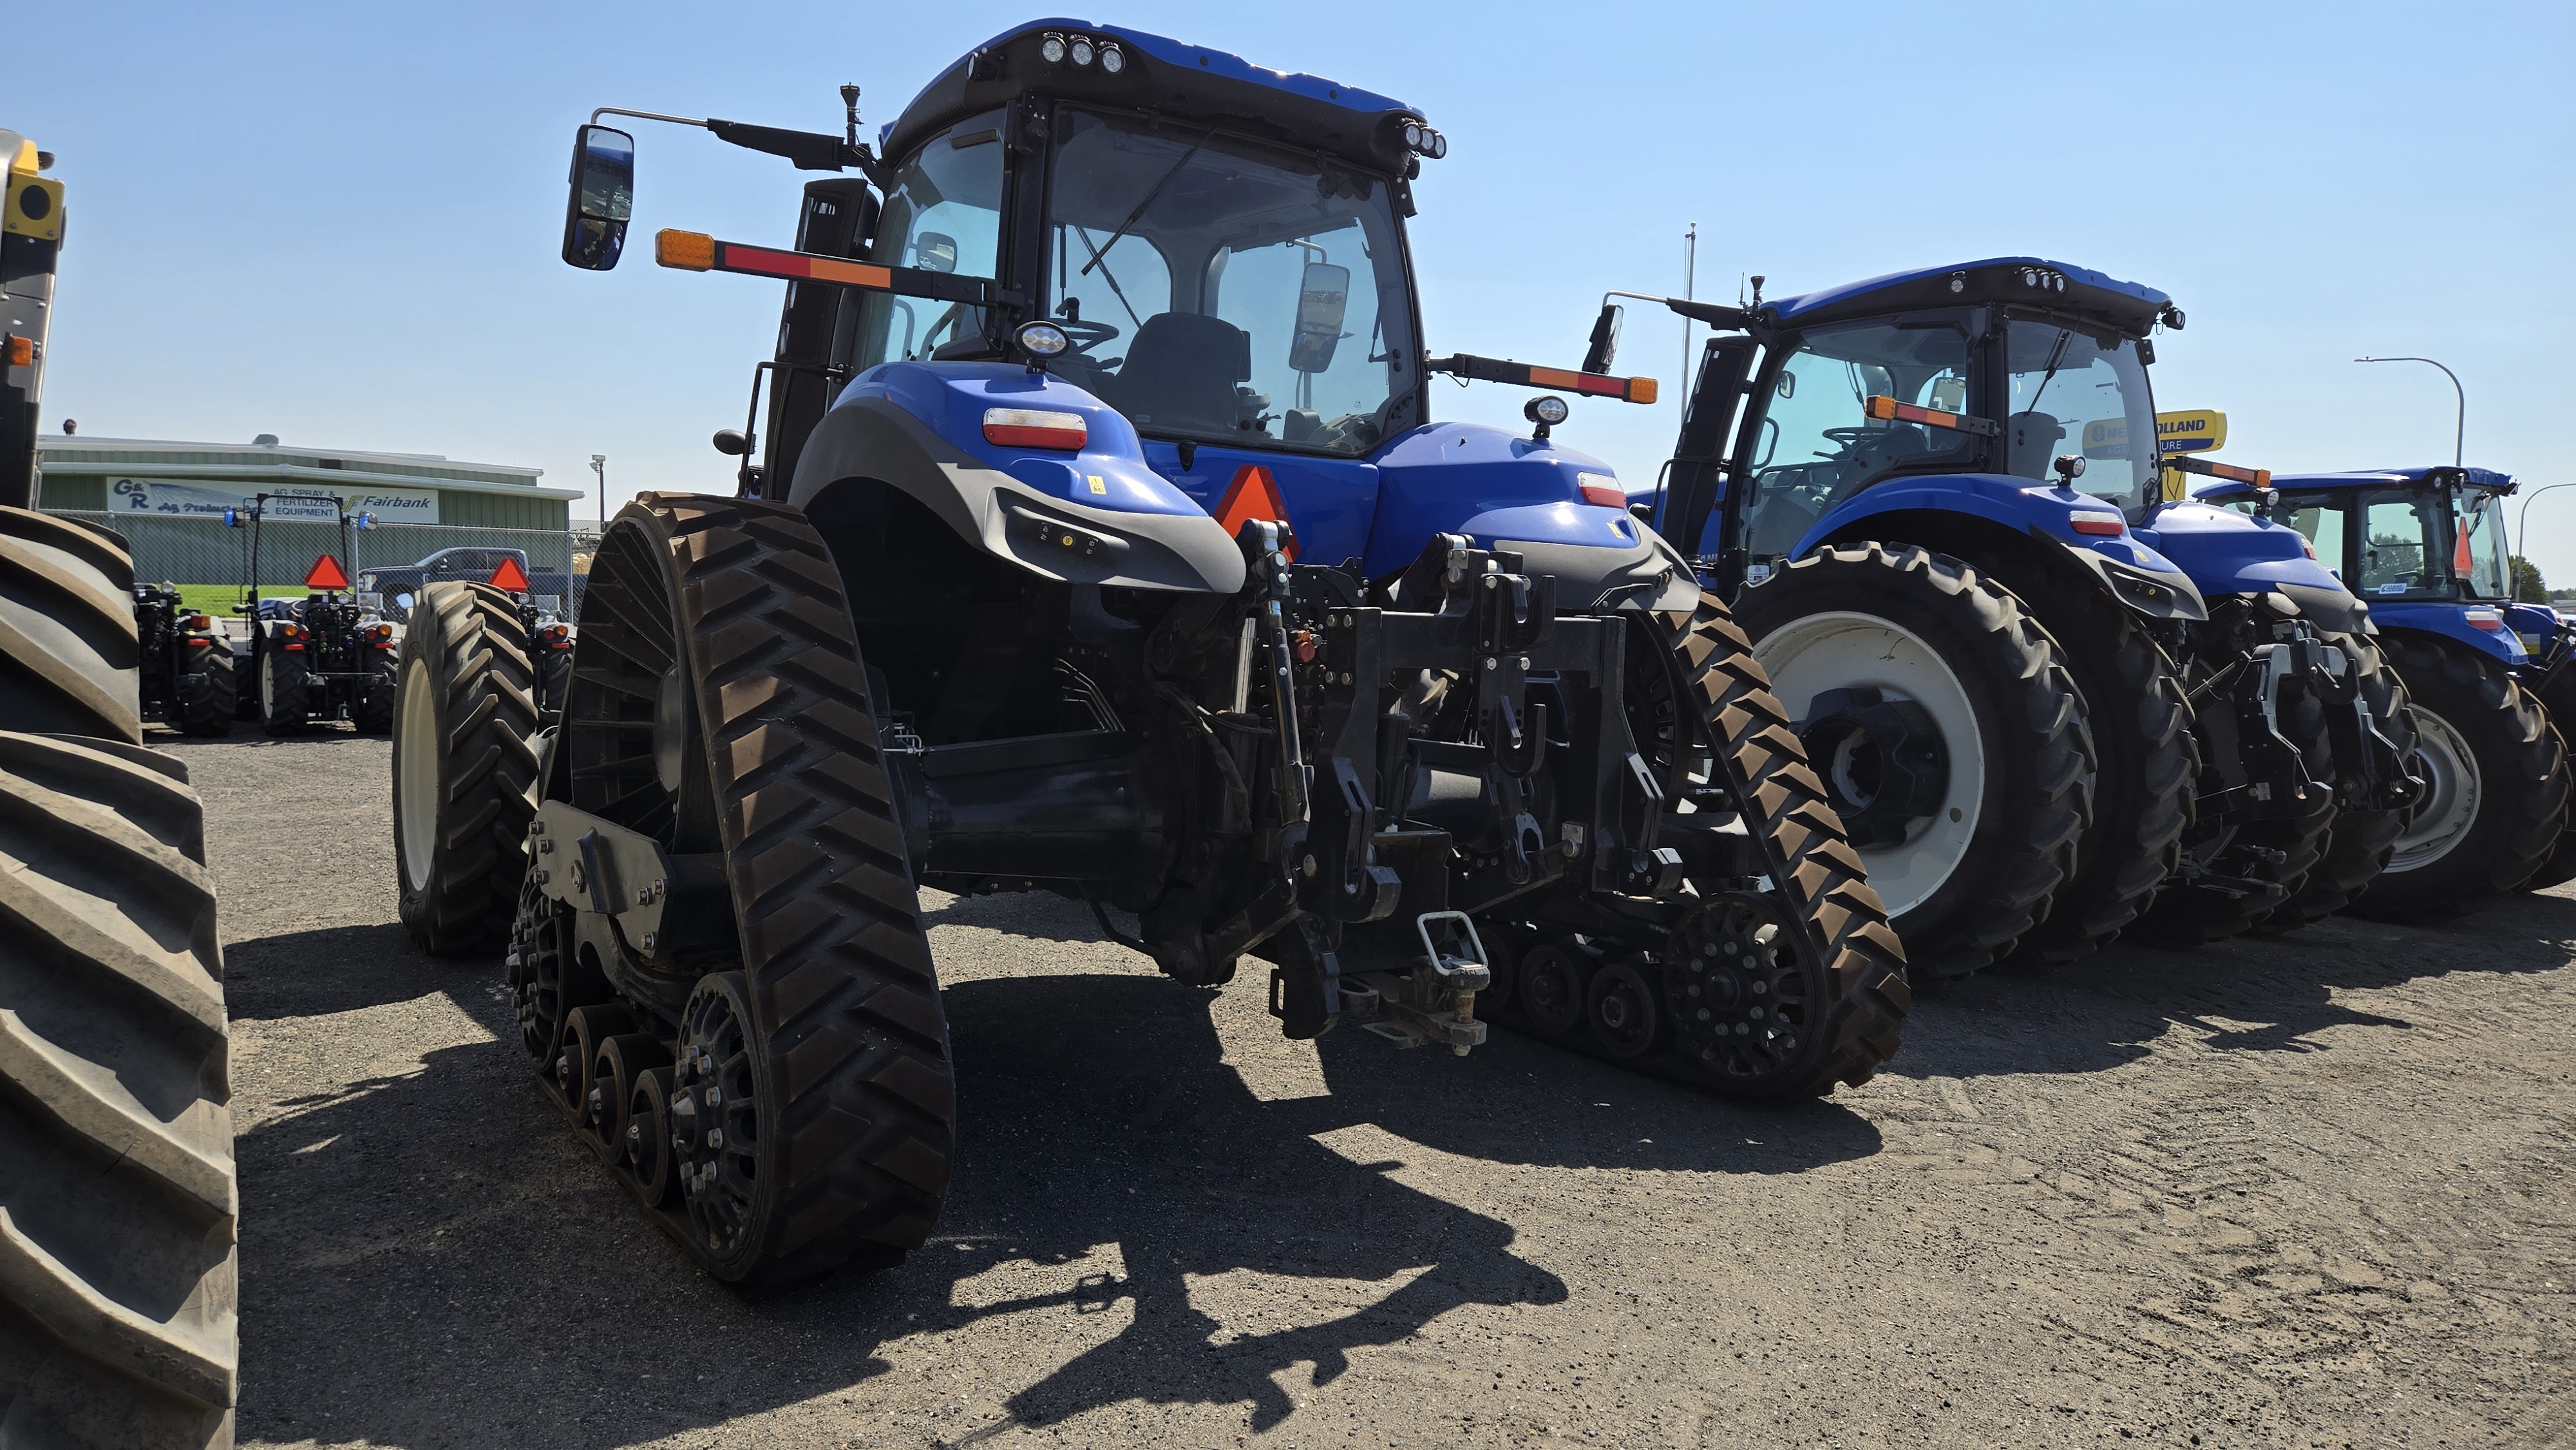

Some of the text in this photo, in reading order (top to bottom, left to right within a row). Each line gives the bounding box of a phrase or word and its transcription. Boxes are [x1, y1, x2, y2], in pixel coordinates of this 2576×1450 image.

[2107, 419, 2206, 438] NE OLLAND
[157, 502, 180, 514] Ag
[183, 502, 233, 514] Product
[276, 498, 334, 507] FERTILIZER
[363, 496, 431, 508] Fairbank
[275, 507, 335, 517] EQUIPMENT
